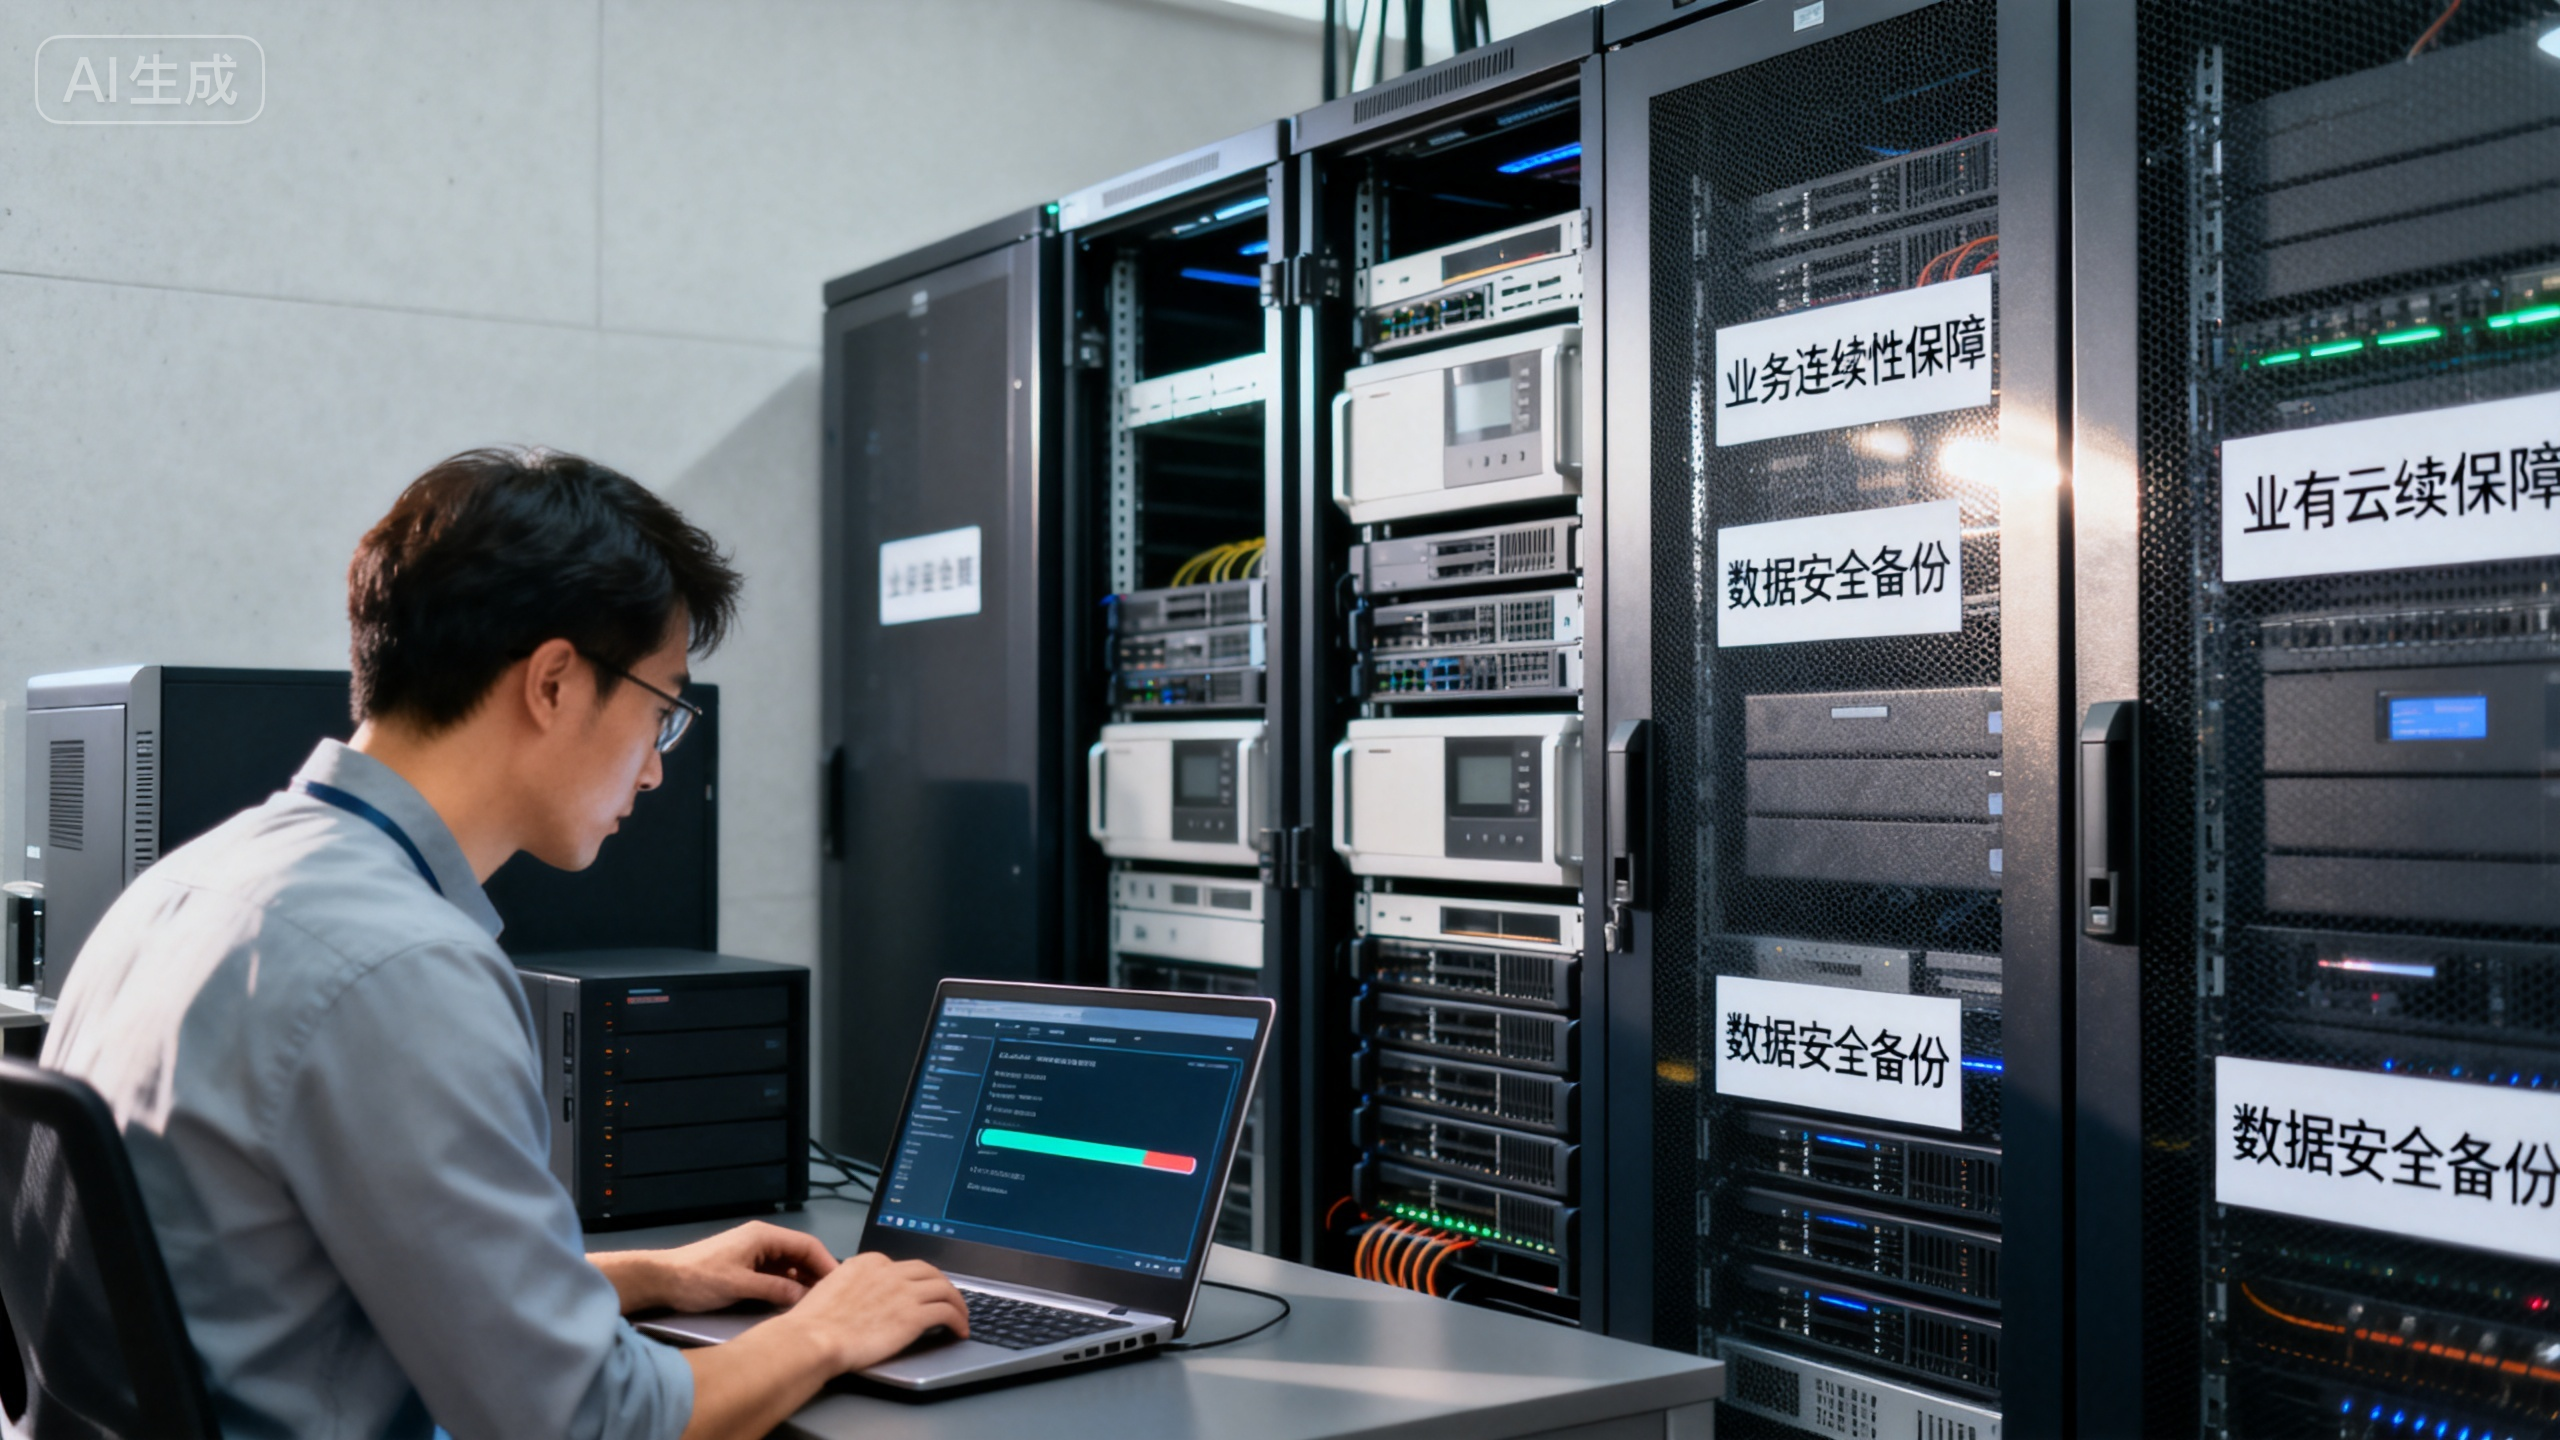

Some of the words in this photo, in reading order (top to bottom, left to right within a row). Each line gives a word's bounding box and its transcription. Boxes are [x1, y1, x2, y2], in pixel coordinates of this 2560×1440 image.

[1725, 314, 1986, 408] 业务连续性保障
[2243, 441, 2560, 534] 业有云续保障
[1727, 540, 1950, 610] 数据安全备份
[1726, 1012, 1949, 1088] 数据安全备份
[2233, 1103, 2560, 1209] 数据安全备份
